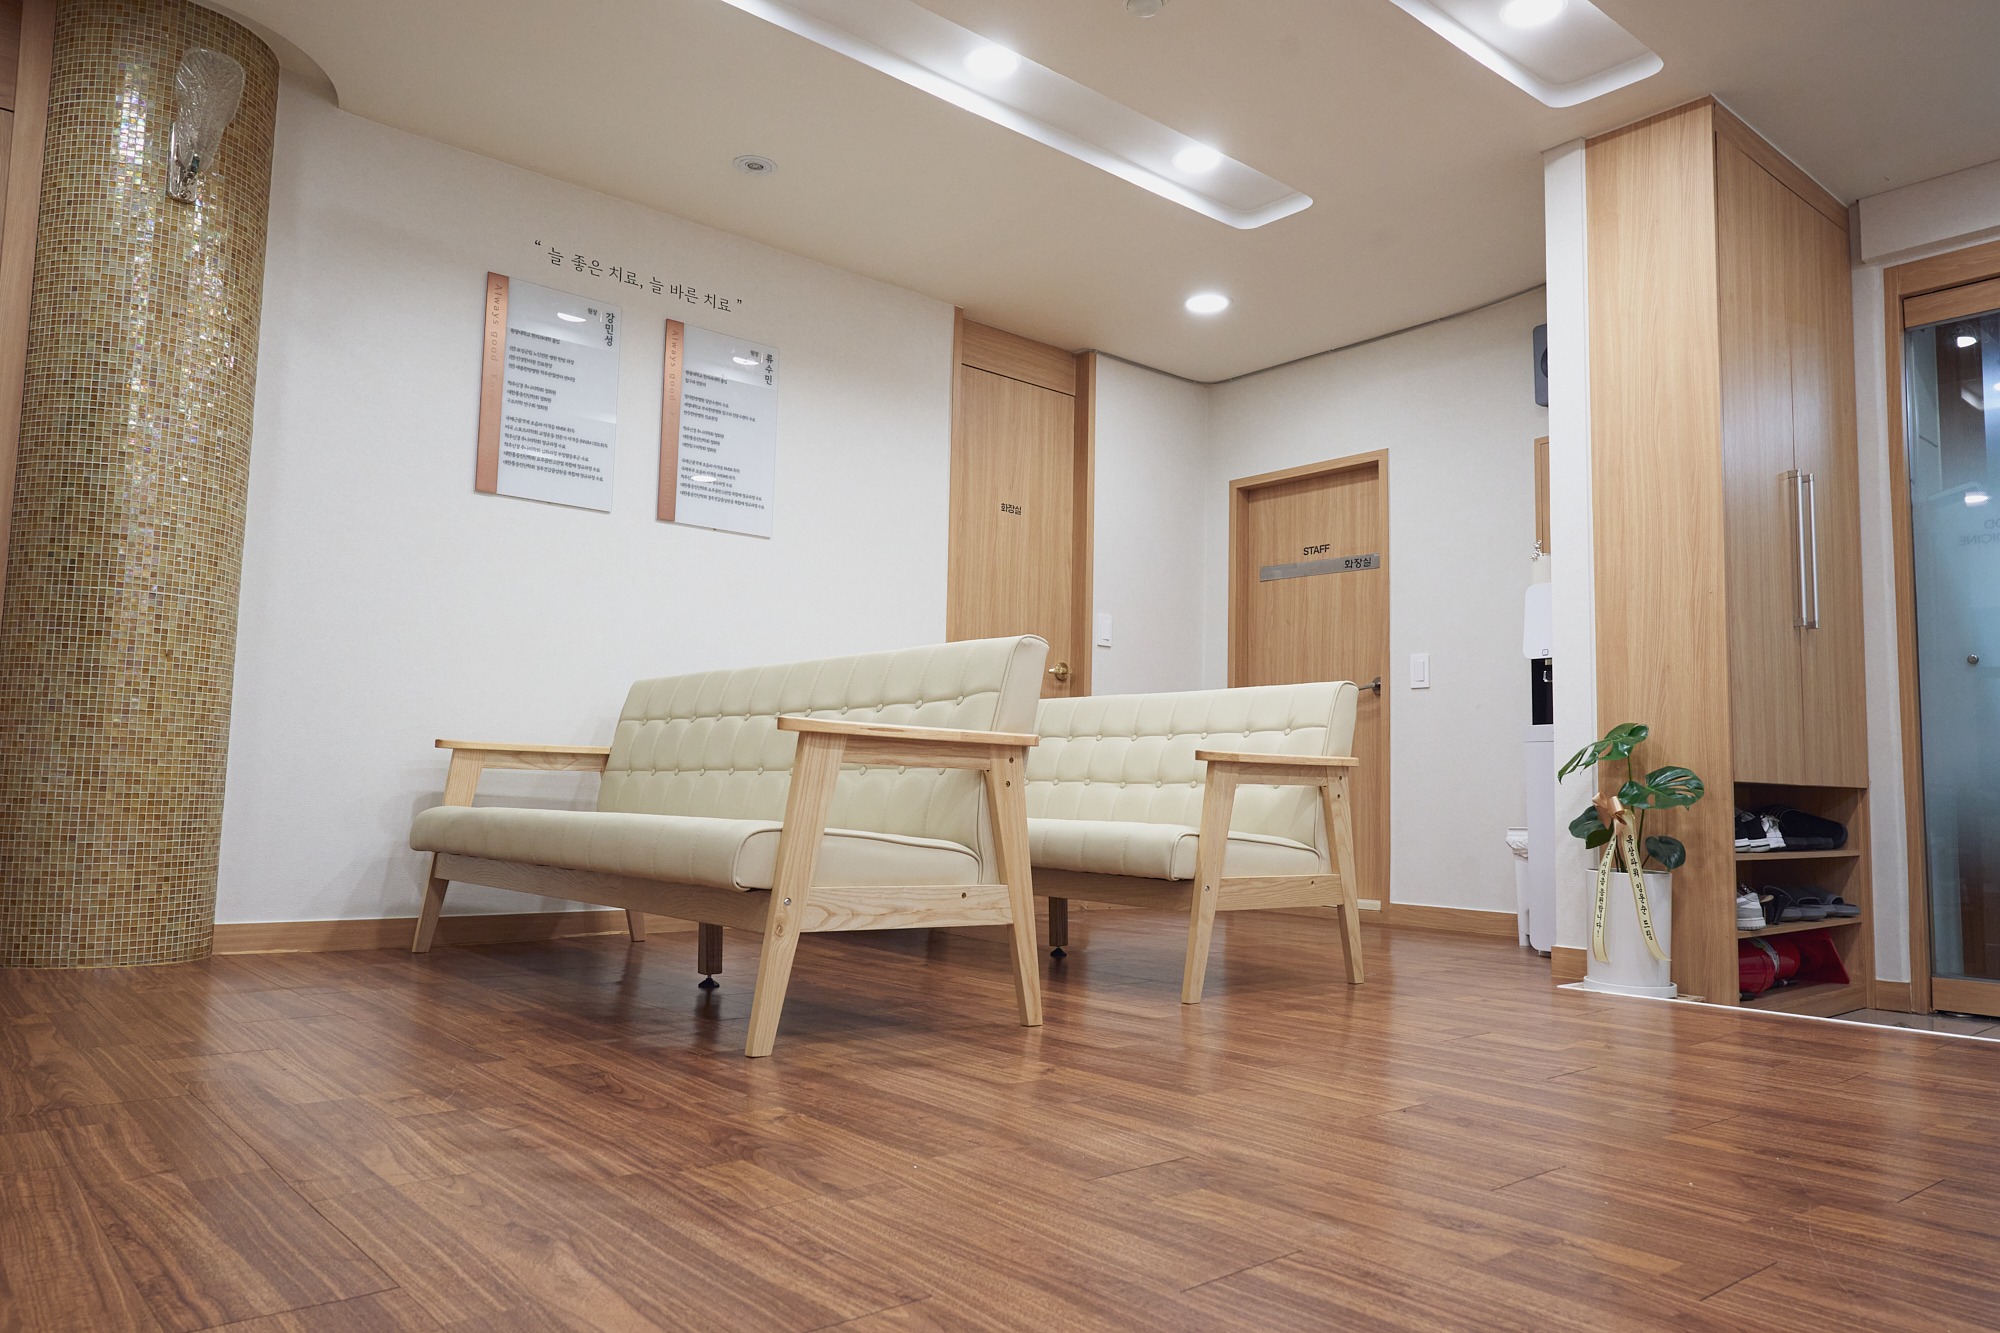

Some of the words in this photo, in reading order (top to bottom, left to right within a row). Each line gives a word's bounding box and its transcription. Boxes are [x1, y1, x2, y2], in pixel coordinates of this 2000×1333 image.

[548, 247, 564, 266] 늘
[572, 254, 603, 278] 좋은
[608, 266, 644, 289] 치료,
[650, 276, 664, 294] 늘
[670, 284, 698, 305] 바른
[704, 293, 732, 312] 치료
[492, 282, 502, 326] Always
[604, 311, 615, 347] 강민성
[488, 330, 499, 362] good
[670, 329, 678, 368] Always
[764, 352, 773, 386] 류수민
[667, 372, 676, 401] good
[1000, 502, 1022, 516] 화장실
[1304, 544, 1330, 556] STAFF
[1344, 557, 1372, 569] 화장실
